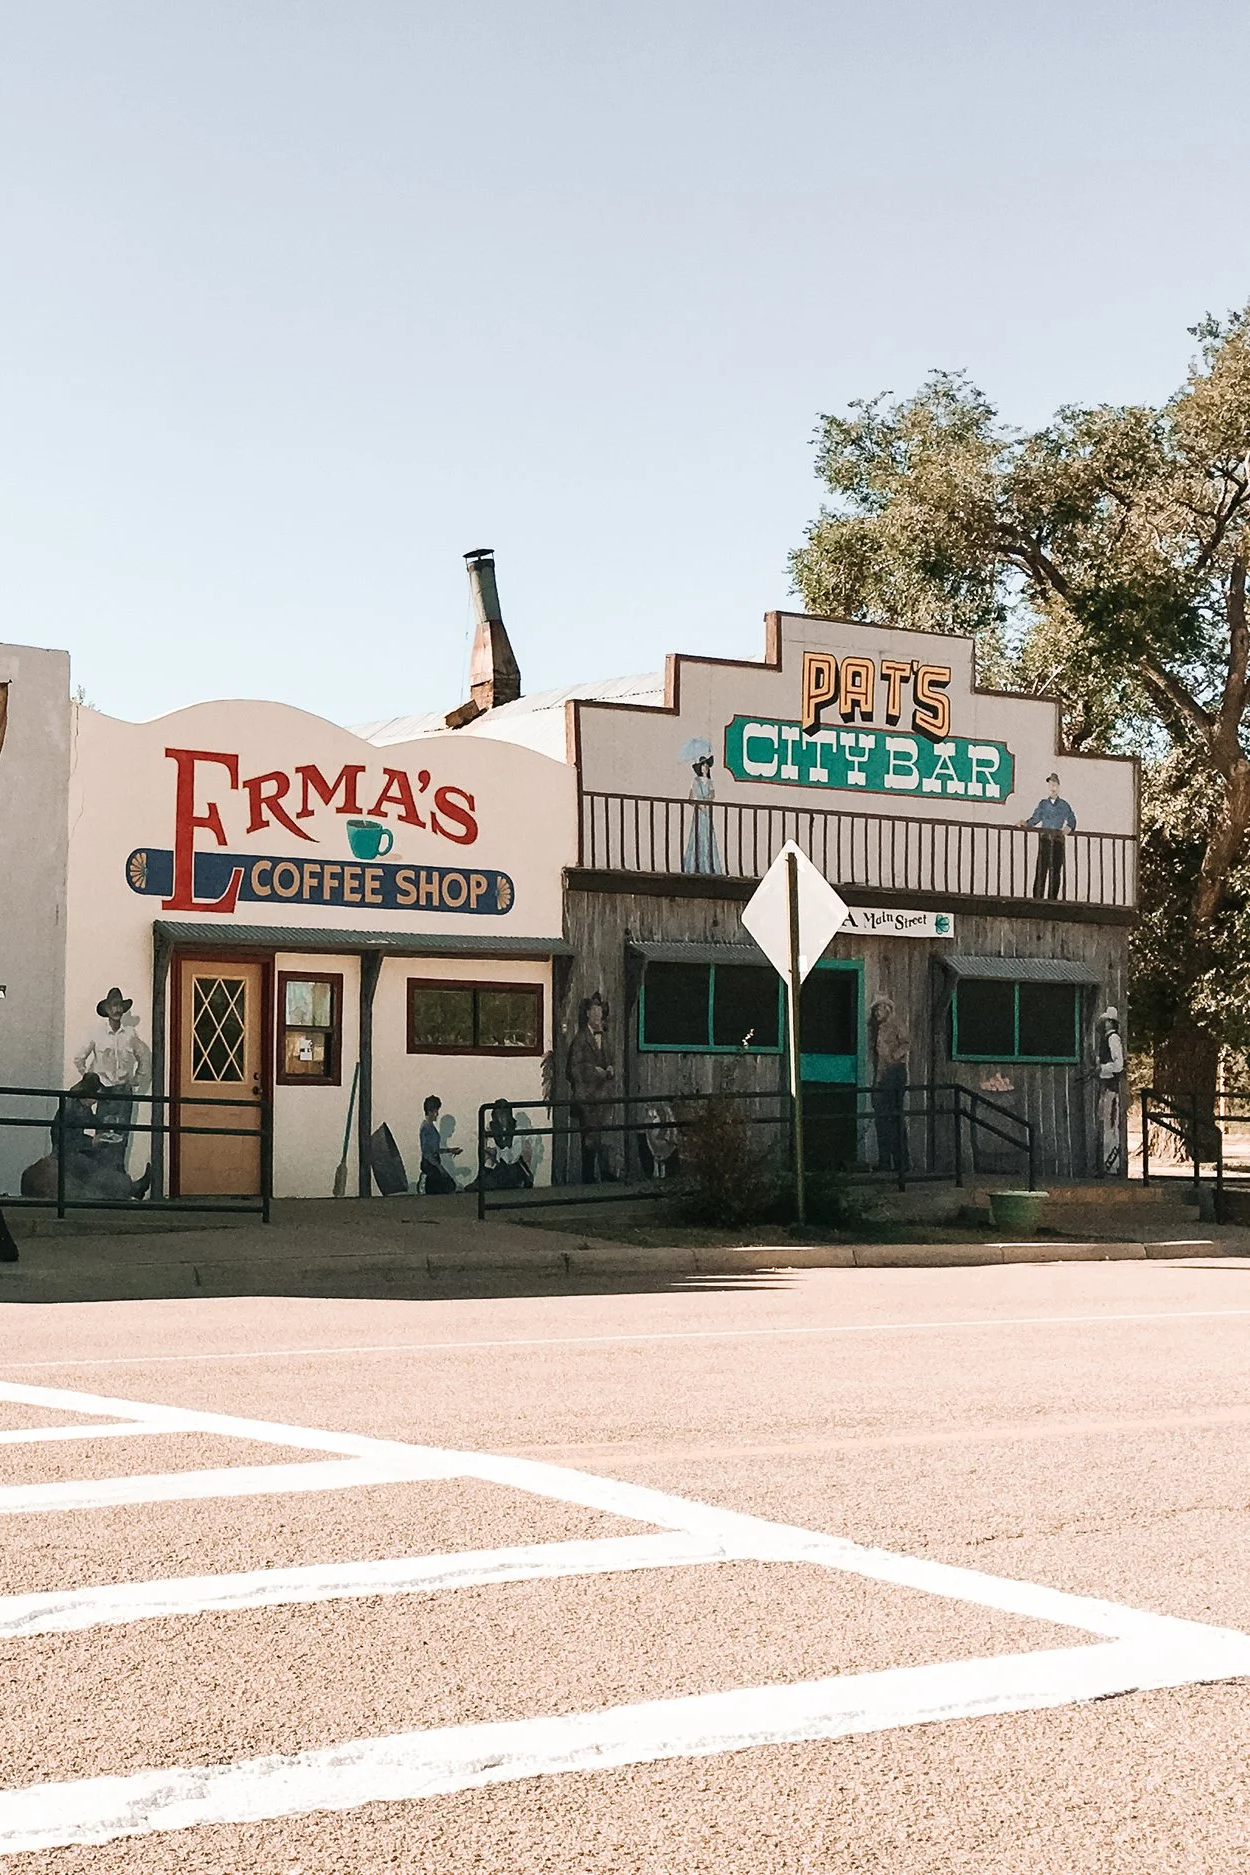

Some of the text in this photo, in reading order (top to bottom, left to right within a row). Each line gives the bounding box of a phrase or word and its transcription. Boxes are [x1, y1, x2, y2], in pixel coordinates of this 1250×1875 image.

[802, 651, 950, 744] PAT'S
[742, 722, 1000, 798] CITY BAR
[161, 747, 479, 913] ERMA'S
[251, 860, 488, 909] COFFEE SHOP
[863, 911, 894, 929] Main
[895, 914, 927, 930] Street
